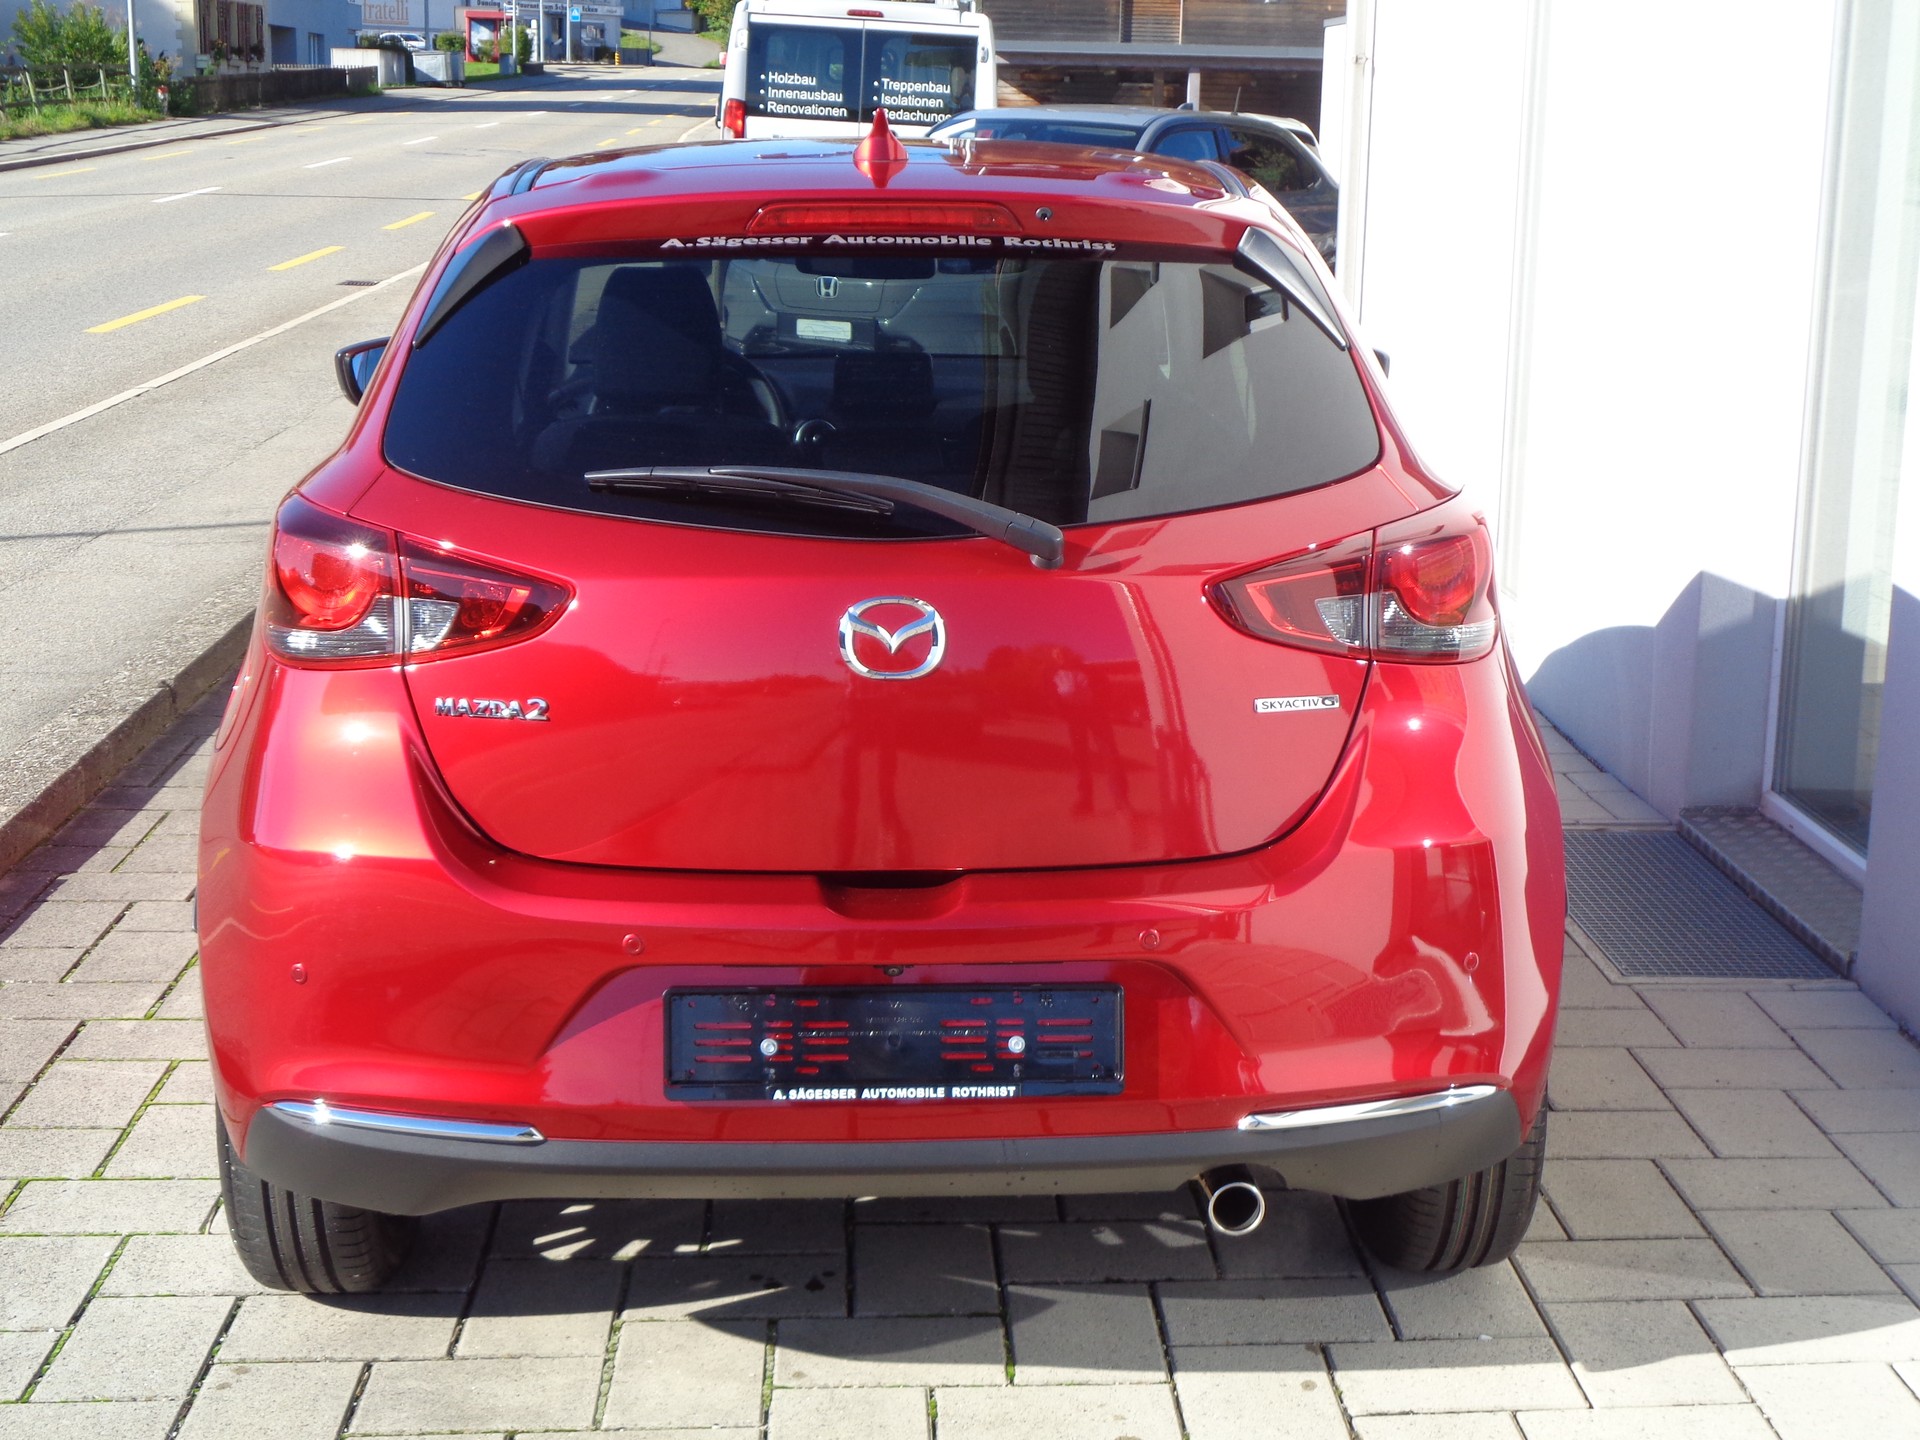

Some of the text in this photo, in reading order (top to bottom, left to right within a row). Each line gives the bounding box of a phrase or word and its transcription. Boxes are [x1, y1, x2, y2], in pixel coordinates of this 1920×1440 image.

[768, 71, 816, 85] Holzbau
[881, 78, 951, 94] Treppenbau
[768, 86, 843, 102] Innenausbau
[881, 93, 944, 108] Isolationen
[767, 101, 847, 117] Renovationen
[823, 234, 992, 246] Automobile
[1003, 236, 1116, 250] Rothrist
[788, 1087, 857, 1100] SÄGESSER
[861, 1087, 945, 1099] AUTOMOBILE
[951, 1085, 1016, 1097] ROTHRIST
